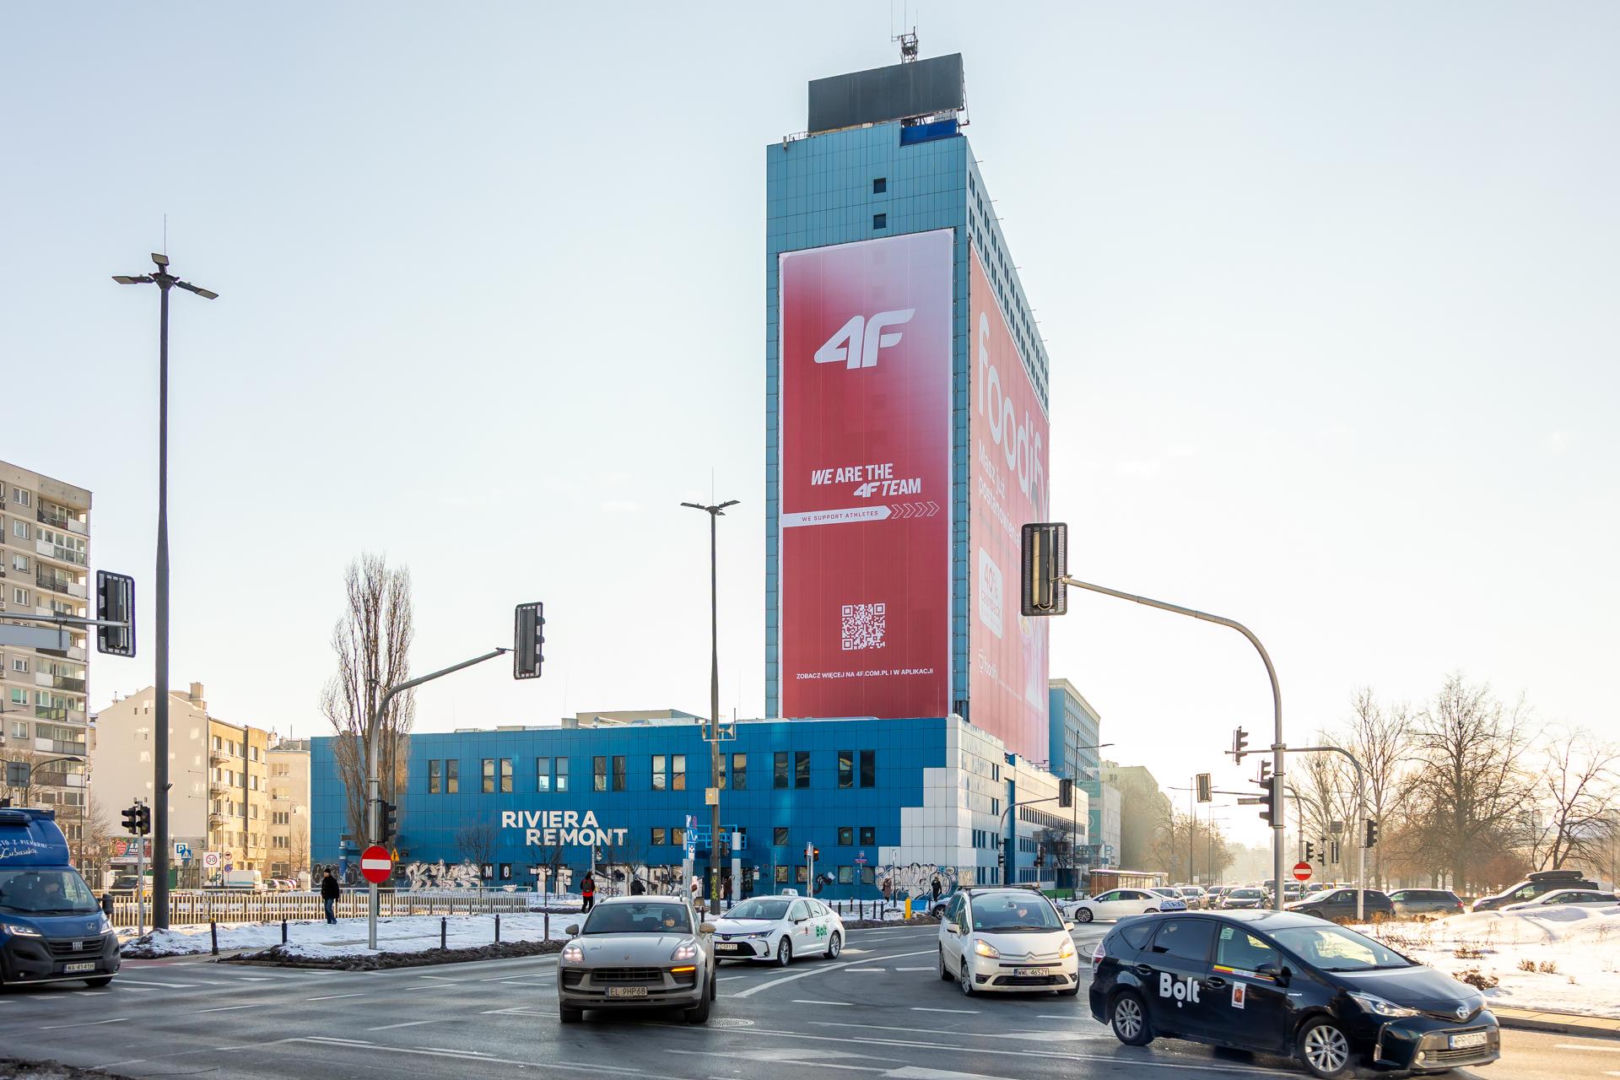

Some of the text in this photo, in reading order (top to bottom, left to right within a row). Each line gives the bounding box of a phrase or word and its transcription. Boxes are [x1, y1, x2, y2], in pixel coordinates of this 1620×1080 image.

[814, 308, 916, 369] 4F
[811, 463, 894, 486] WE ARE THE
[853, 478, 921, 498] 4F TEAM
[801, 510, 879, 523] WE SUPPORT ATHLETES
[796, 672, 821, 680] ZOBACZ
[821, 671, 845, 680] WIĘCEJ
[502, 810, 599, 828] RIVIERA
[526, 828, 628, 846] REMONT
[1160, 971, 1200, 1008] Bolt
